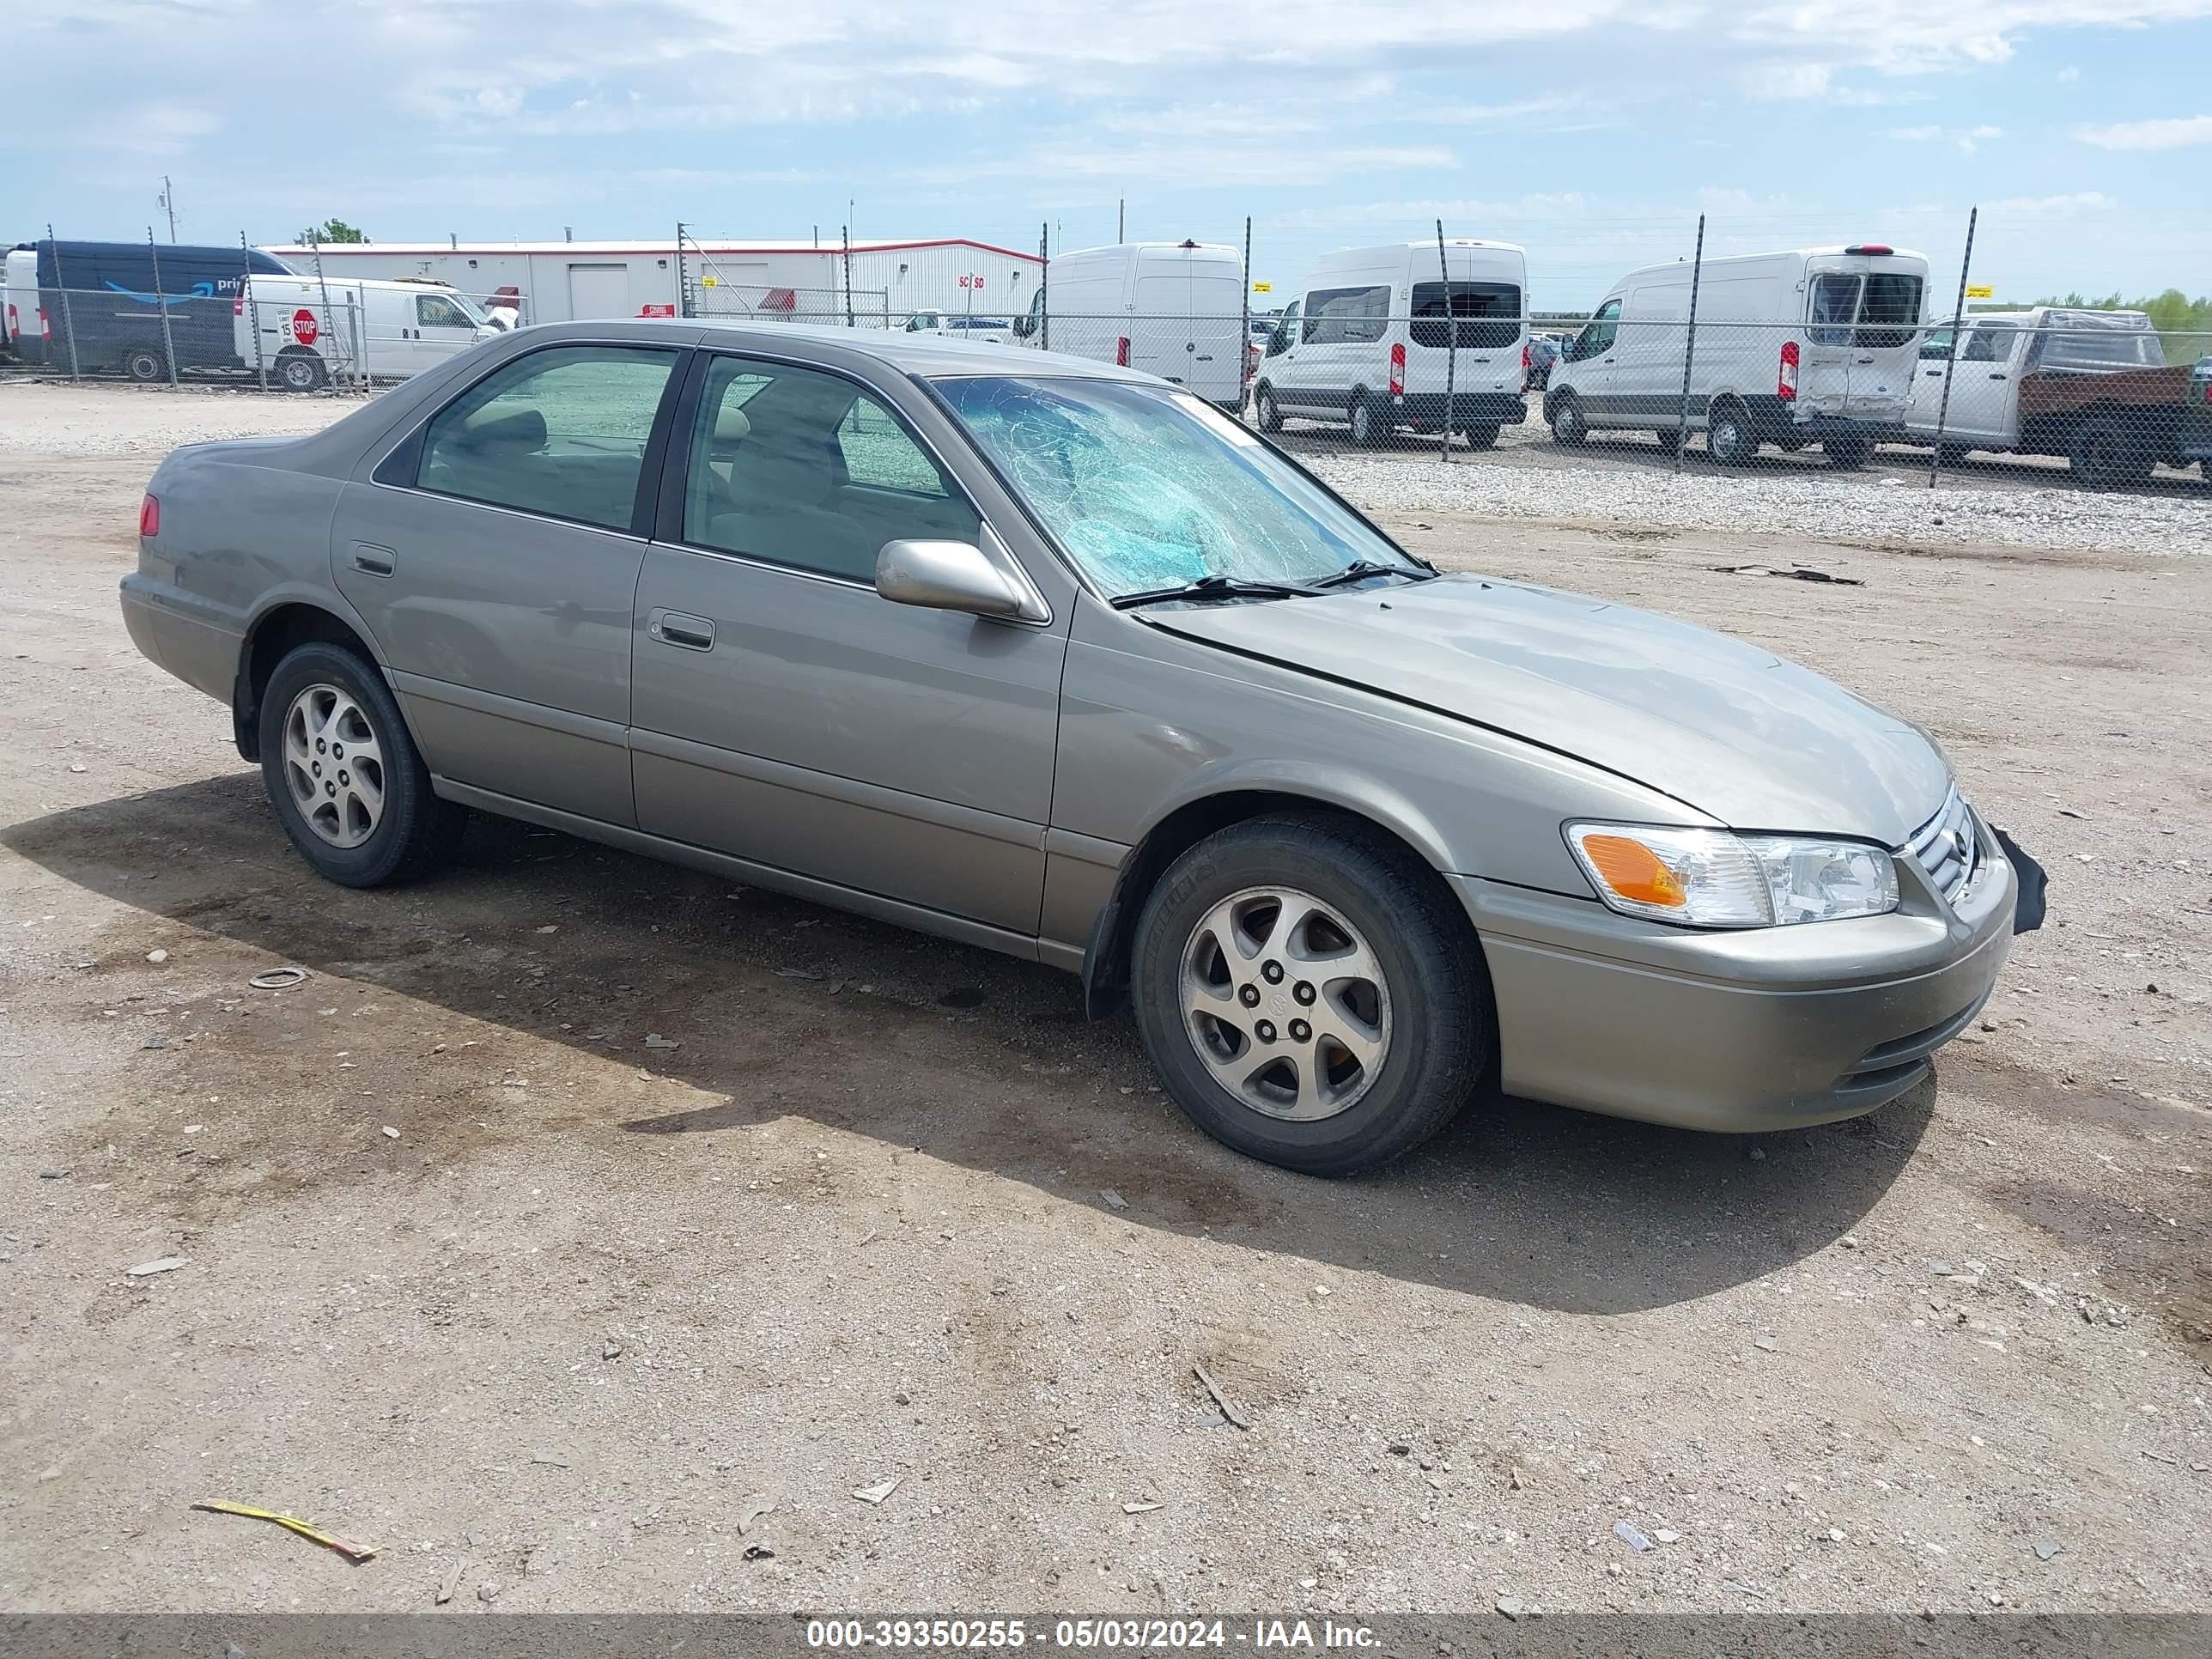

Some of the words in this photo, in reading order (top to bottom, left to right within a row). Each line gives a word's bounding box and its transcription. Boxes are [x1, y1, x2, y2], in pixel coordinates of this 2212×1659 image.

[217, 277, 240, 291] pri
[959, 276, 969, 288] SC
[974, 276, 983, 288] SD
[282, 324, 291, 336] 15
[295, 320, 315, 334] STOP
